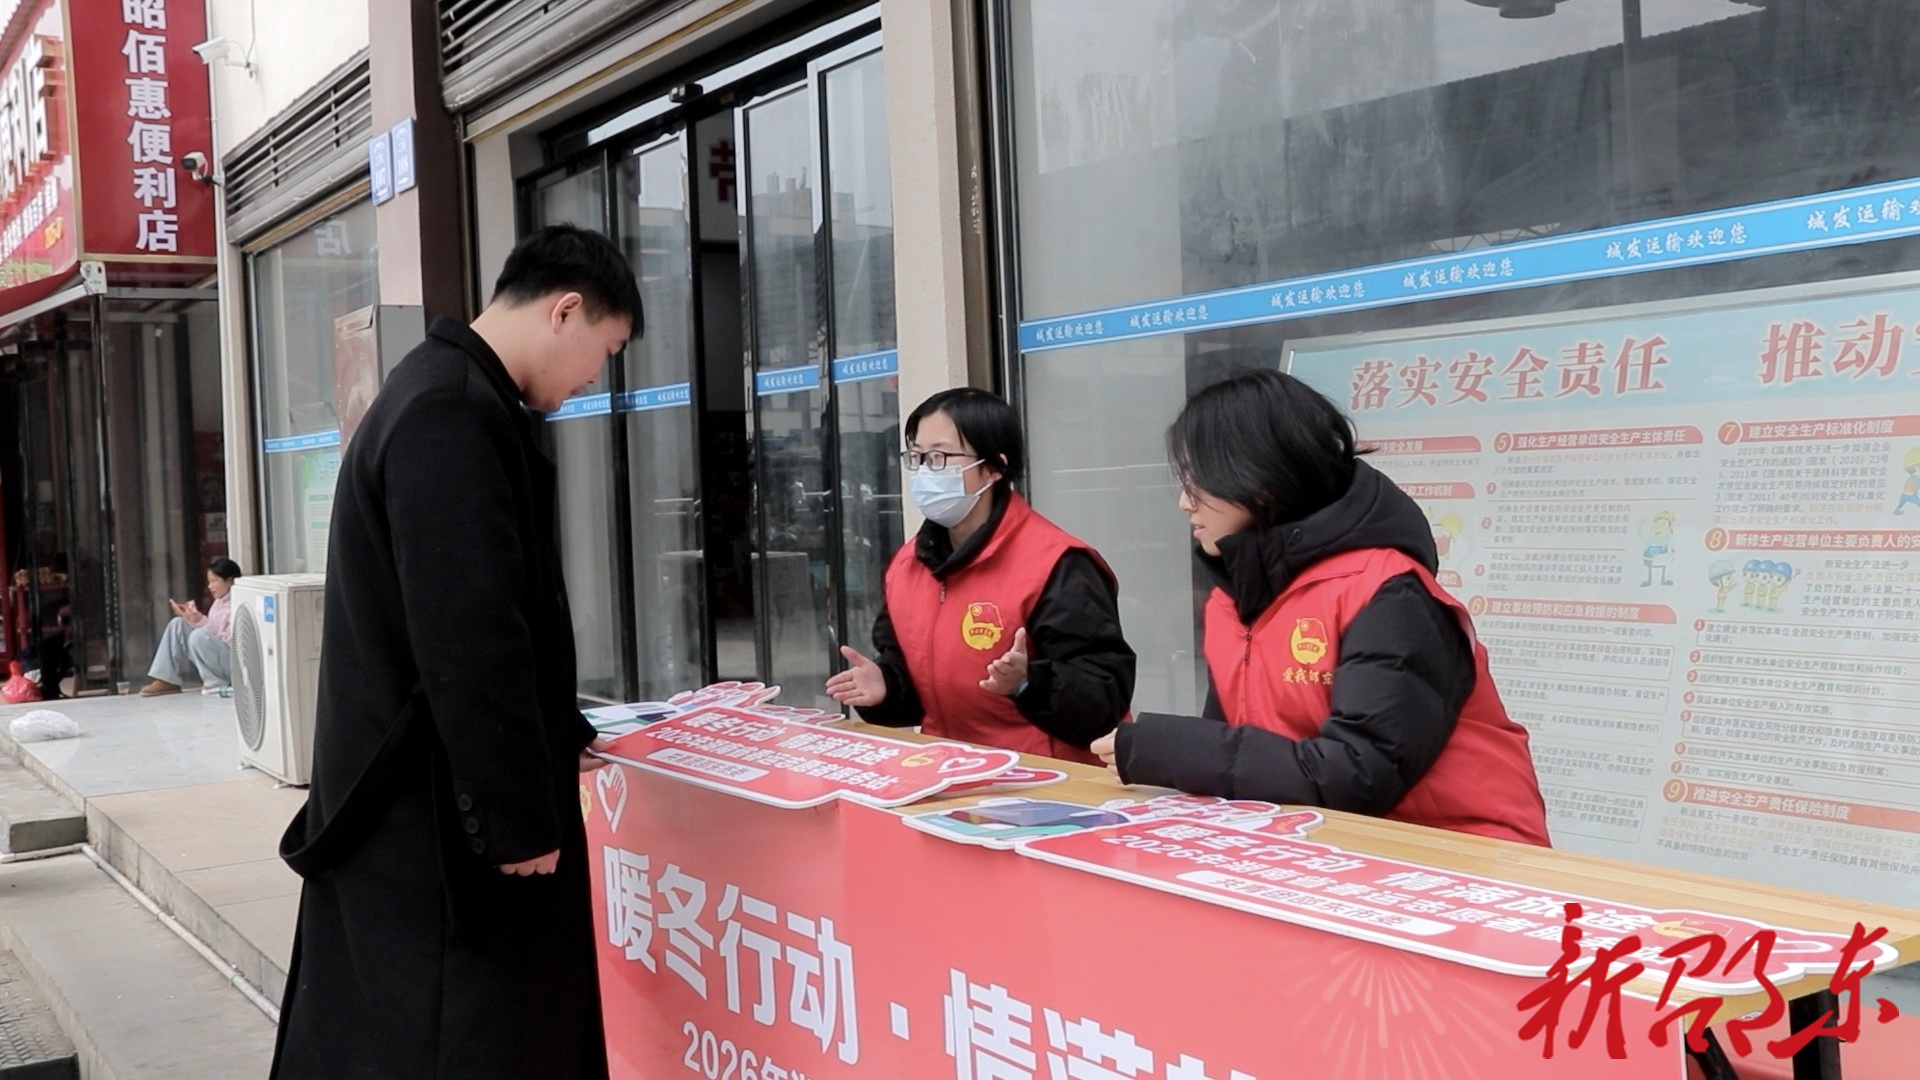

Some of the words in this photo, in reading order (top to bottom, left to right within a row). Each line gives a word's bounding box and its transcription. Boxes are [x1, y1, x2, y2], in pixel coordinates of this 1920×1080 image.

[122, 0, 178, 252] 昭佰惠便利店
[1035, 321, 1105, 342] 城发运输欢迎您
[1129, 303, 1209, 330] 城发运输欢迎您
[1271, 280, 1366, 309] 城发运输欢迎您
[1402, 257, 1514, 290] 城发运输欢迎您
[1606, 221, 1748, 261] 城发运输欢迎您
[1350, 336, 1668, 411] 落实安全责任
[1758, 313, 1920, 385] 推动
[1518, 429, 1686, 448] 强化生产经营单位安全生产主体责任
[1749, 419, 1895, 439] 建立安全生产标准化制度
[681, 711, 788, 743] 暖冬行动
[775, 731, 901, 766] 情满旅途
[1693, 785, 1851, 821] 推进安全生产责任保险制度
[1143, 823, 1367, 873] 暖冬行动
